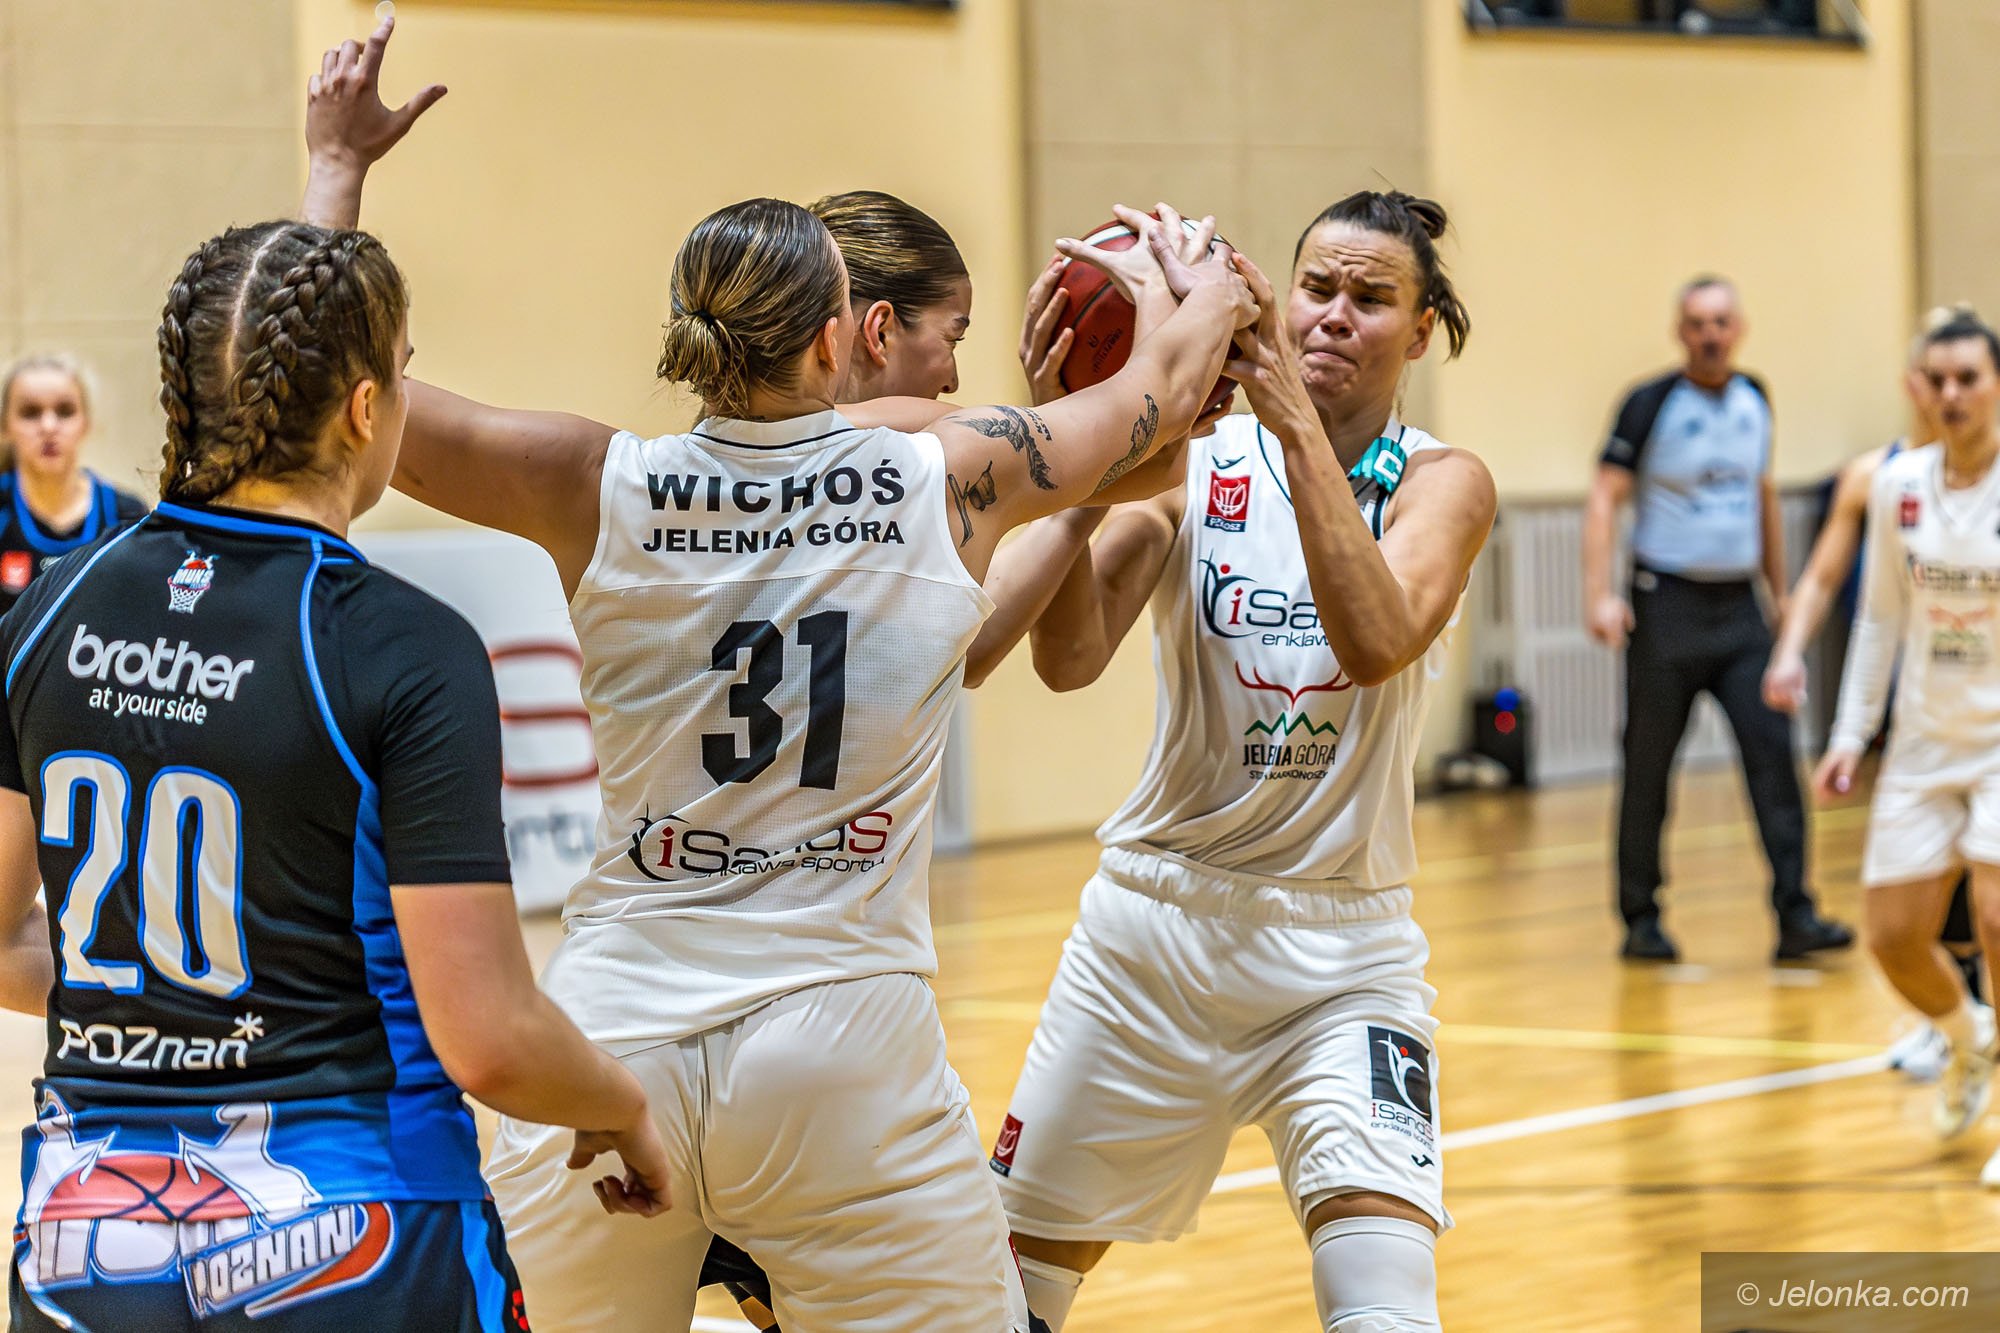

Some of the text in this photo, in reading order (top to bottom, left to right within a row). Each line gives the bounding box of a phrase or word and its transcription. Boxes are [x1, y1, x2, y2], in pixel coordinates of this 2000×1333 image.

[647, 458, 905, 514] WICHOŚ
[642, 516, 906, 554] JELENIA GÓRA
[1228, 587, 1324, 630] iSa
[67, 623, 256, 702] brother
[89, 686, 208, 725] at your side
[701, 610, 849, 791] 31
[1294, 741, 1337, 766] GÓRA
[40, 749, 254, 999] 20
